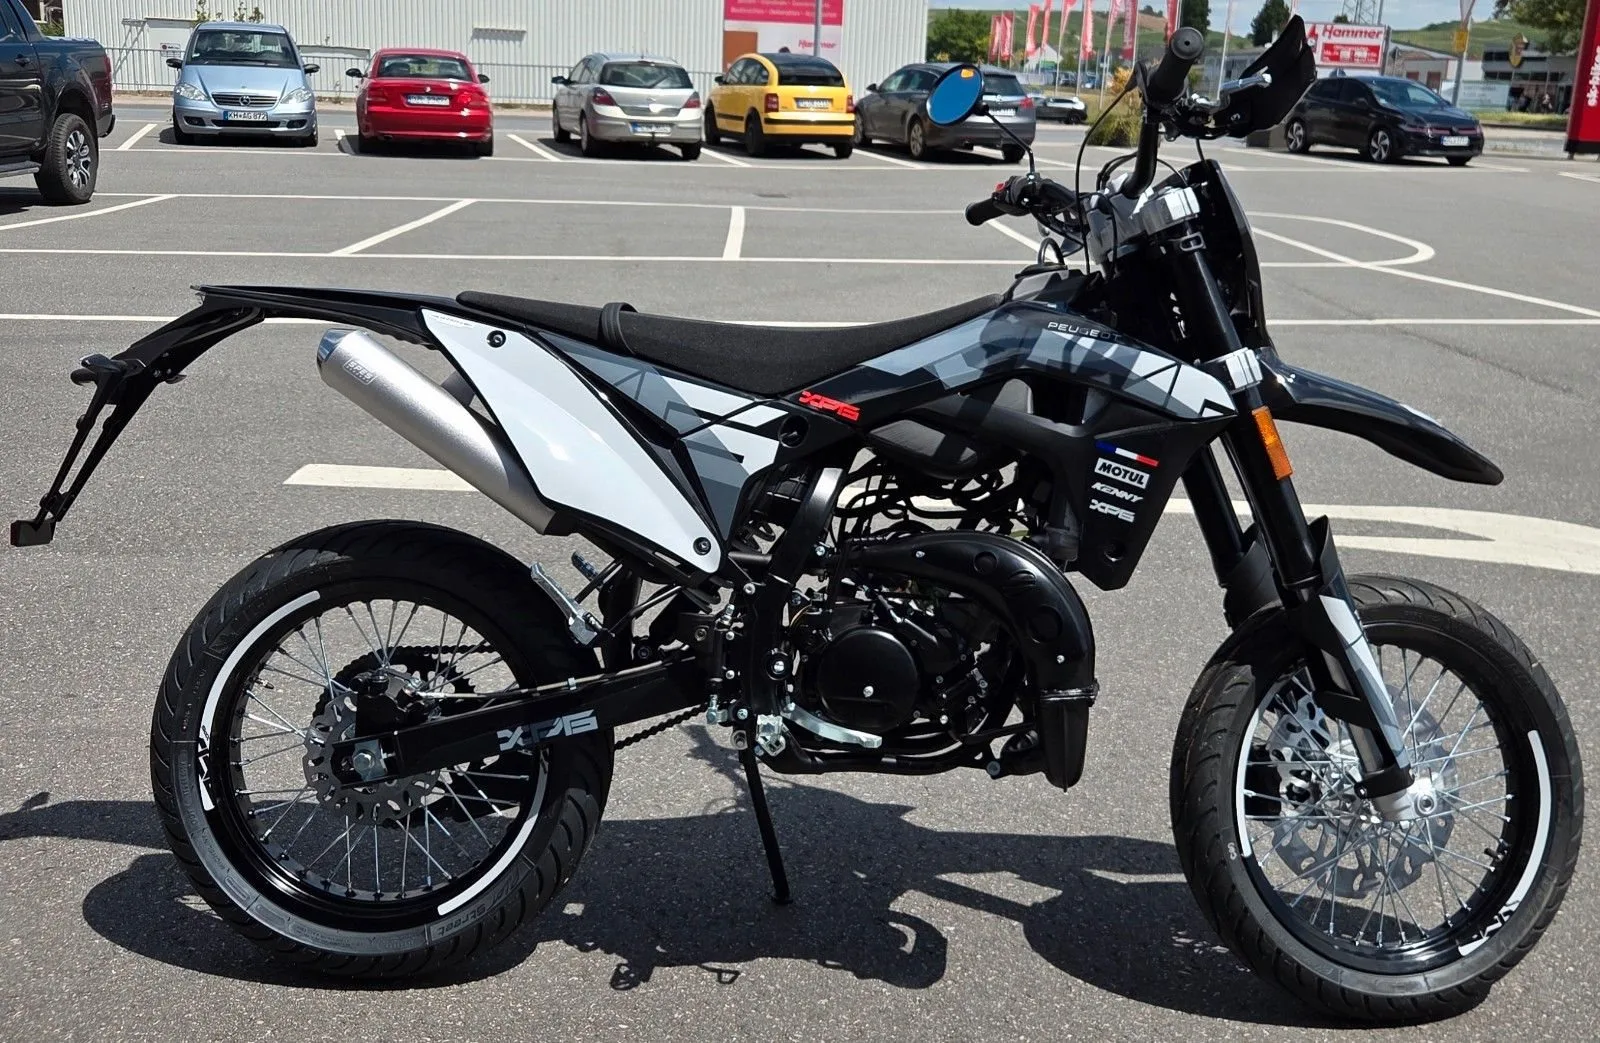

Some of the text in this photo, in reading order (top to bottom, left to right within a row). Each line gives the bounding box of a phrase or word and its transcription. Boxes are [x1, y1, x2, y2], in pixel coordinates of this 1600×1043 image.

[1322, 24, 1382, 39] Hammer
[798, 39, 836, 49] Hamer
[1047, 321, 1122, 342] PEUGEOT
[348, 361, 374, 380] SPES
[1098, 462, 1146, 486] MOTUL
[1091, 482, 1143, 503] KENNY
